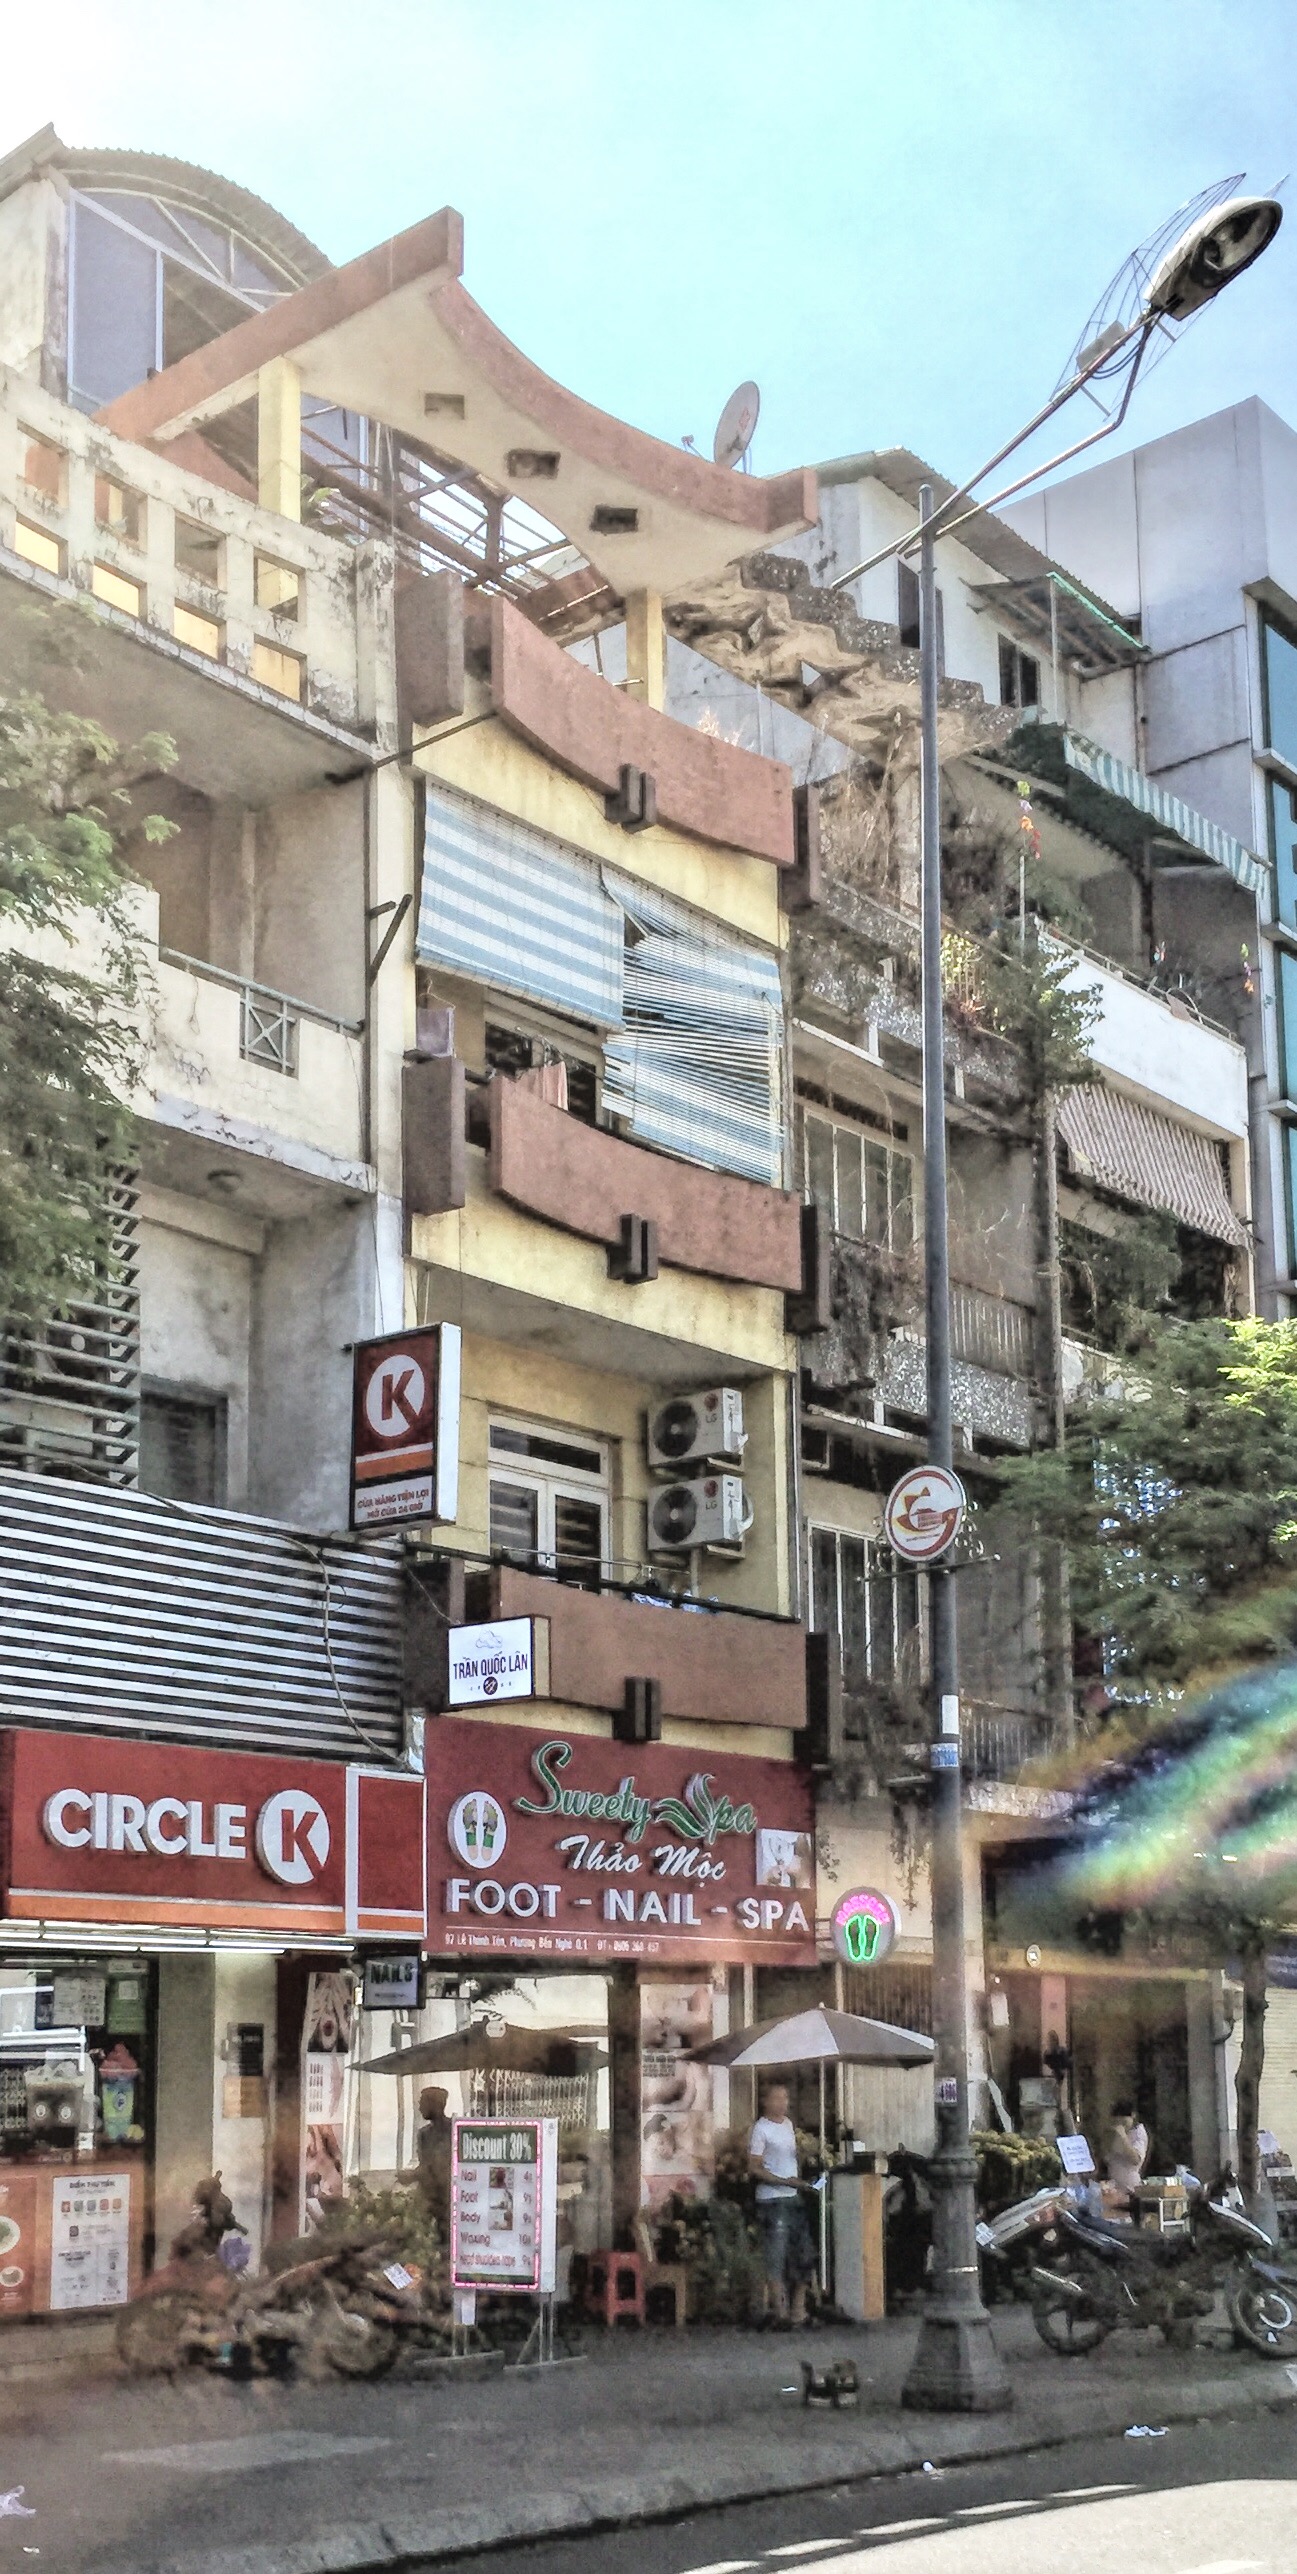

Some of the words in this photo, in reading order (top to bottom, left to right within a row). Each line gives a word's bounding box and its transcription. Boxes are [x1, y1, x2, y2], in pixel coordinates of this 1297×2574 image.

[705, 1413, 717, 1423] LG
[705, 1502, 718, 1510] LG
[453, 1656, 478, 1679] TRẦN
[480, 1651, 506, 1676] QUỐC
[509, 1650, 528, 1673] LÂN
[515, 1741, 652, 1843] Sweety
[44, 1788, 247, 1860] CIRCLE
[558, 1834, 643, 1874] Thảo
[653, 1843, 727, 1888] Mộc
[447, 1878, 561, 1918] FOOT
[604, 1888, 702, 1926] NAIL
[739, 1898, 810, 1932] SPA
[462, 2132, 508, 2160] Discount
[510, 2132, 532, 2160] 30%
[460, 2211, 481, 2224] Body
